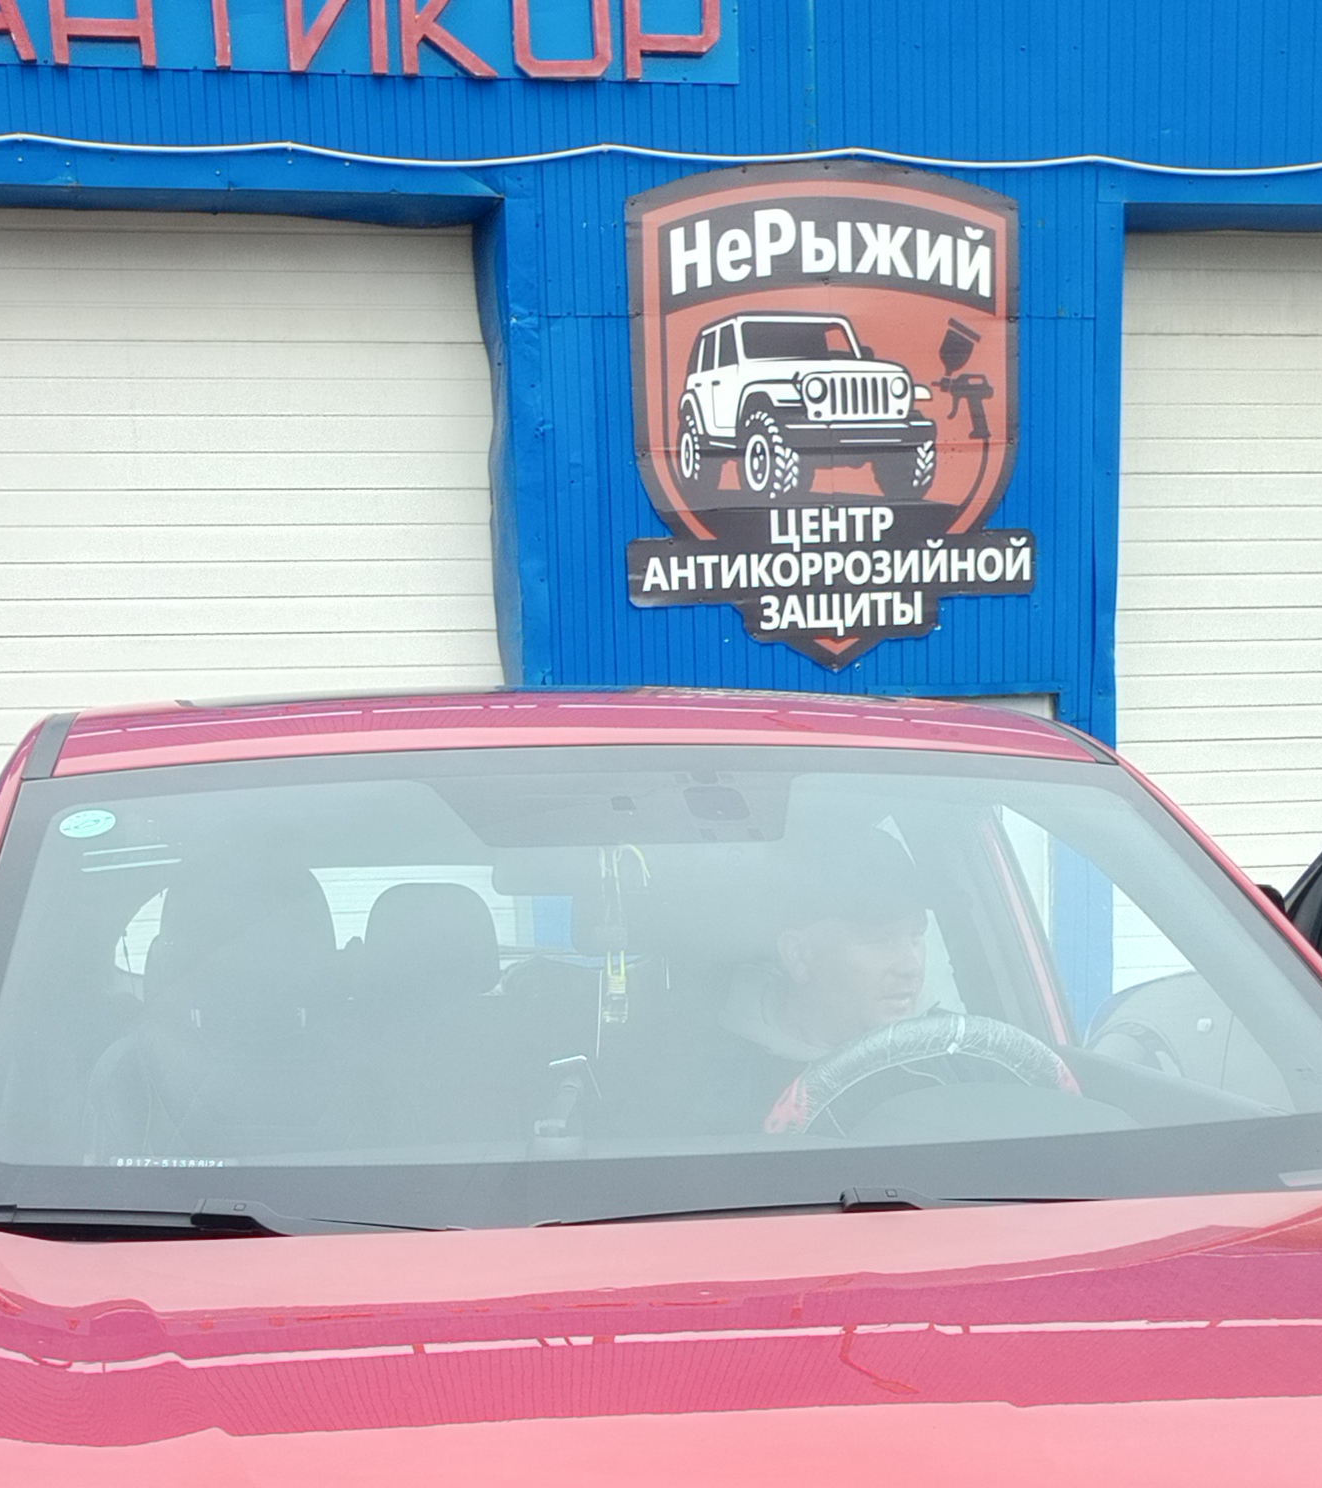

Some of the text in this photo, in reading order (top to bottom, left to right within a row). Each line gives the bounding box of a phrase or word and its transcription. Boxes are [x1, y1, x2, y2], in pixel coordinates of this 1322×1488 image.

[670, 208, 993, 298] НеРыжий
[769, 506, 895, 551] ЦЕНТР
[641, 537, 1032, 592] АНТИКОРРОЗИЙНОЙ
[759, 592, 923, 636] ЗАЩИТЫ
